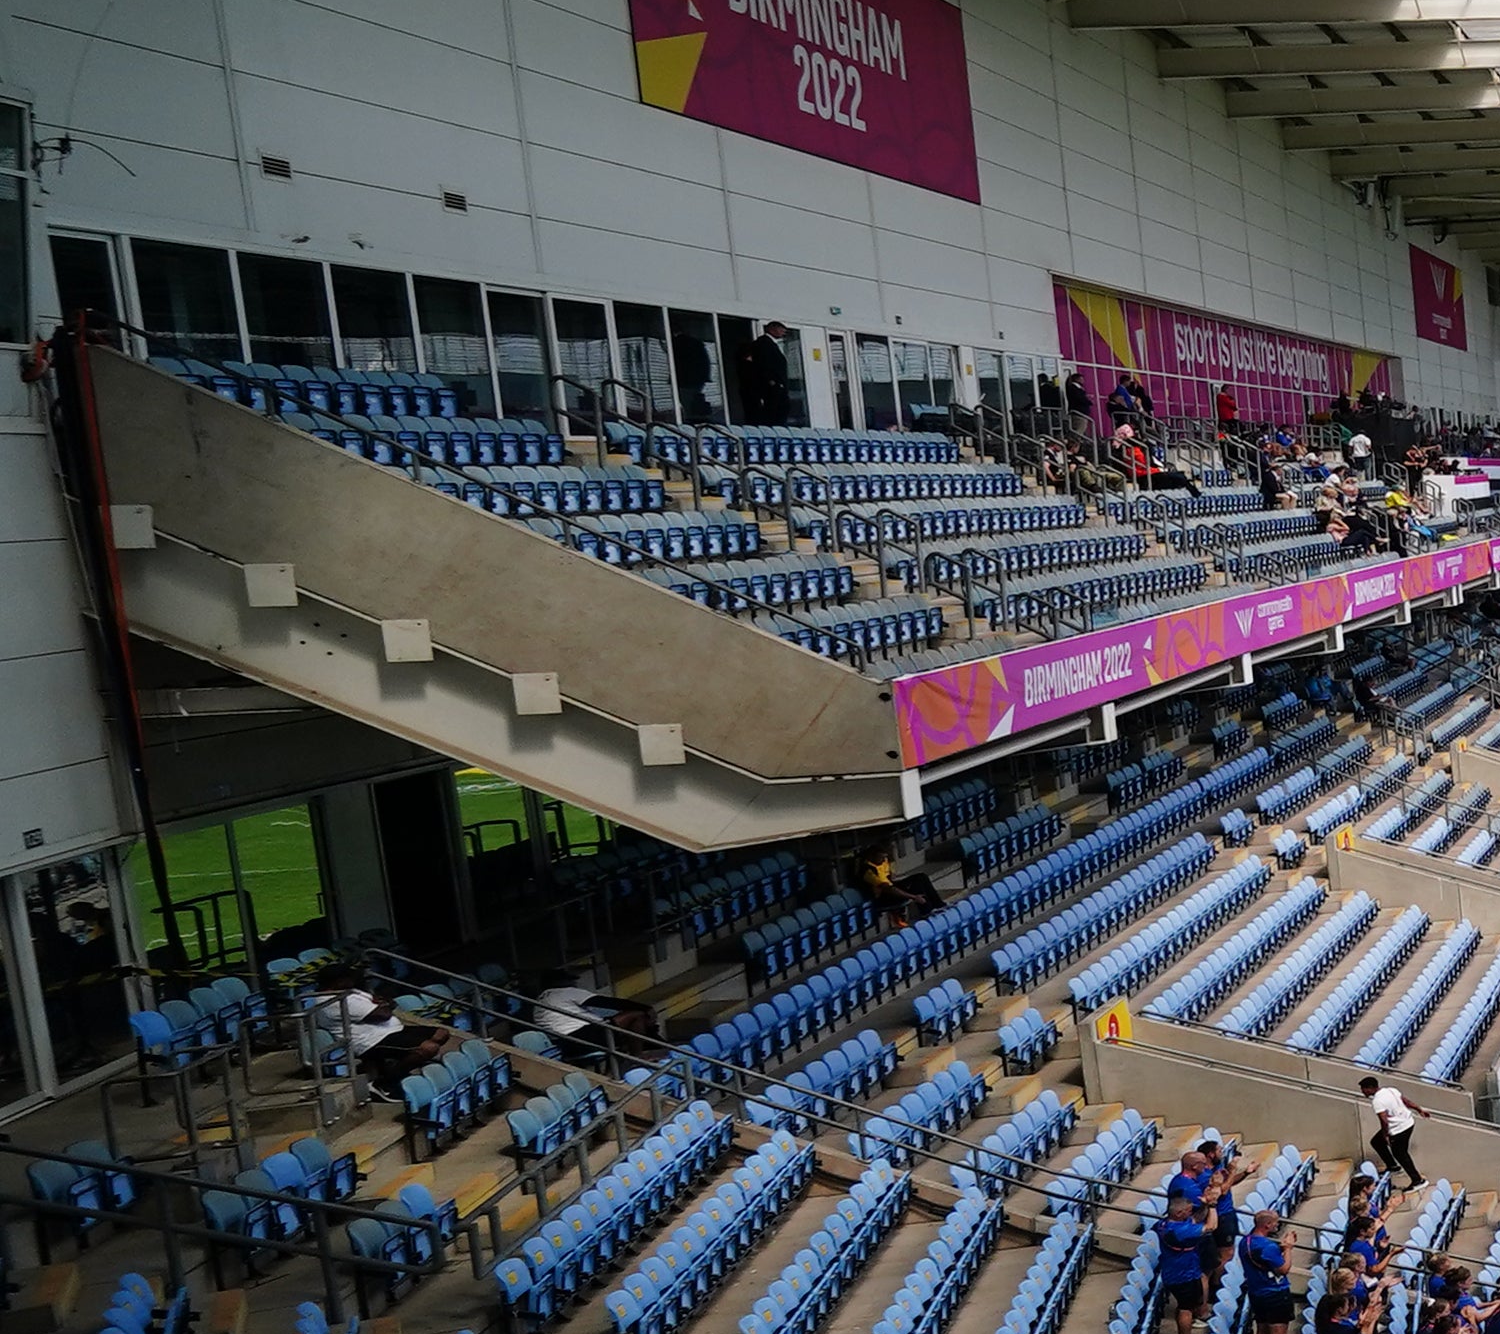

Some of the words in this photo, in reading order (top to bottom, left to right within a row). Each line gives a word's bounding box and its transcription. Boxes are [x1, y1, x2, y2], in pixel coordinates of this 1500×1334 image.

[793, 44, 867, 131] 2022
[1174, 322, 1216, 373] sport
[1229, 327, 1255, 379] just
[1276, 336, 1329, 392] beginning
[1024, 649, 1101, 707] BIRMINGHAM
[1103, 642, 1133, 683] 2022
